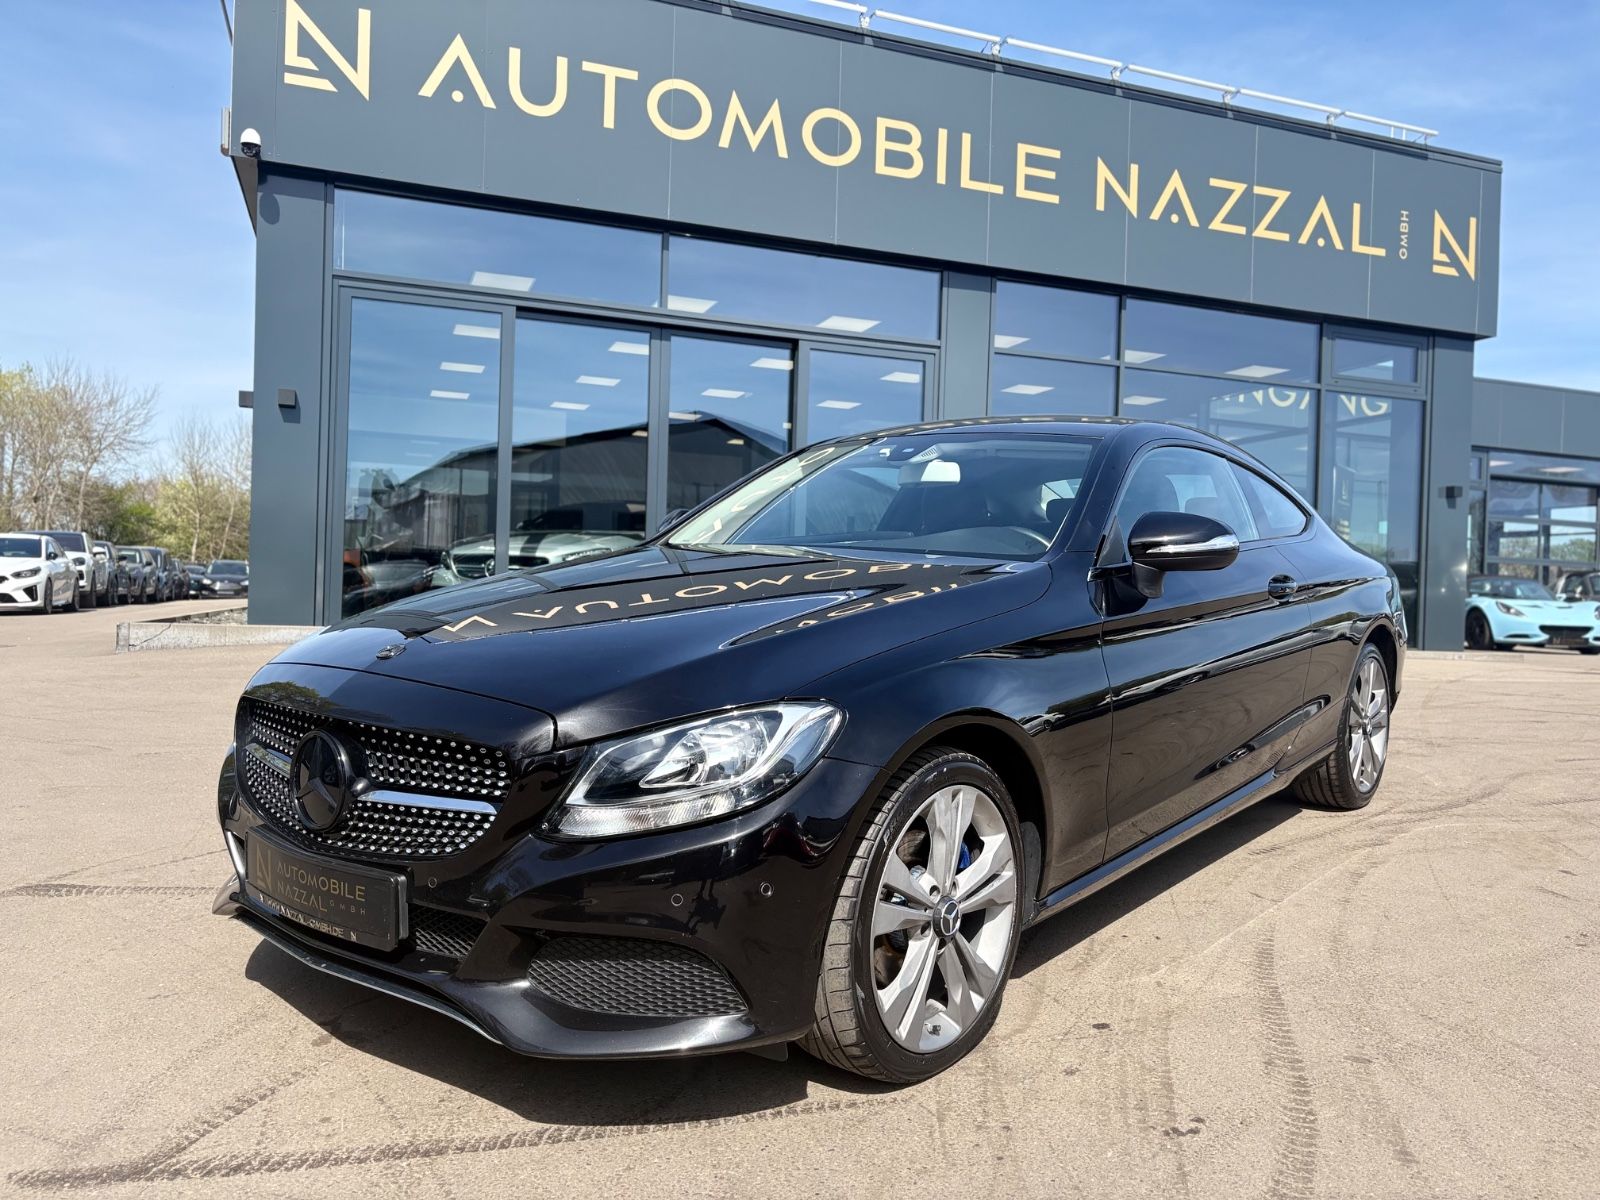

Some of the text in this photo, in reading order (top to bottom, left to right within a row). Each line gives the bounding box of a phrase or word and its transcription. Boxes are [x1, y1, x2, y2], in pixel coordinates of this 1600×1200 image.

[418, 33, 1061, 204] AUTOMOBILE
[1096, 156, 1386, 257] NAZZAL
[1399, 210, 1409, 260] GMBH
[277, 860, 366, 902] AUTOMOBILE
[277, 880, 328, 913] NAZZAL
